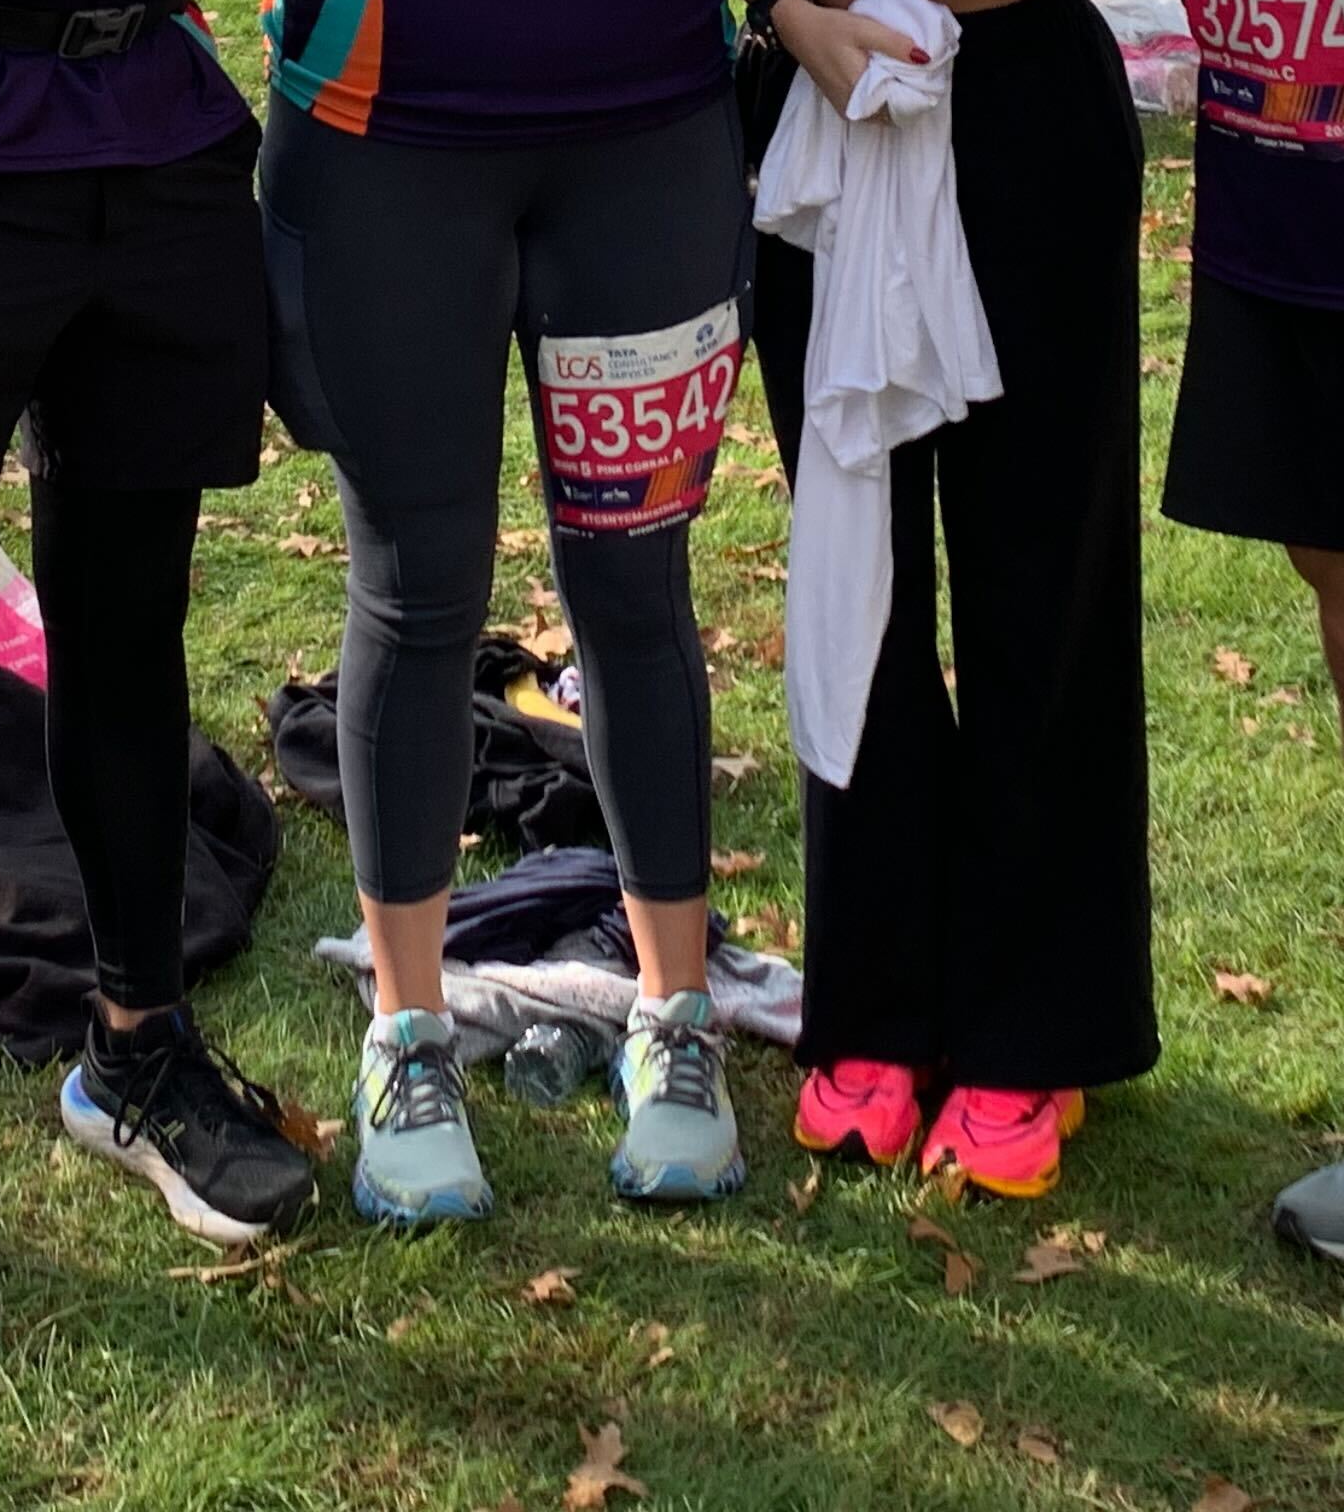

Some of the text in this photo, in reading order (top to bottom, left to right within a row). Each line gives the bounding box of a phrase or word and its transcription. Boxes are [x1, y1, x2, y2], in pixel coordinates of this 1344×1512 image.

[1282, 65, 1295, 81] C
[556, 351, 603, 379] tcs
[608, 349, 637, 358] TATA
[550, 353, 735, 458] 53542
[597, 461, 623, 475] PINK
[673, 447, 685, 462] A
